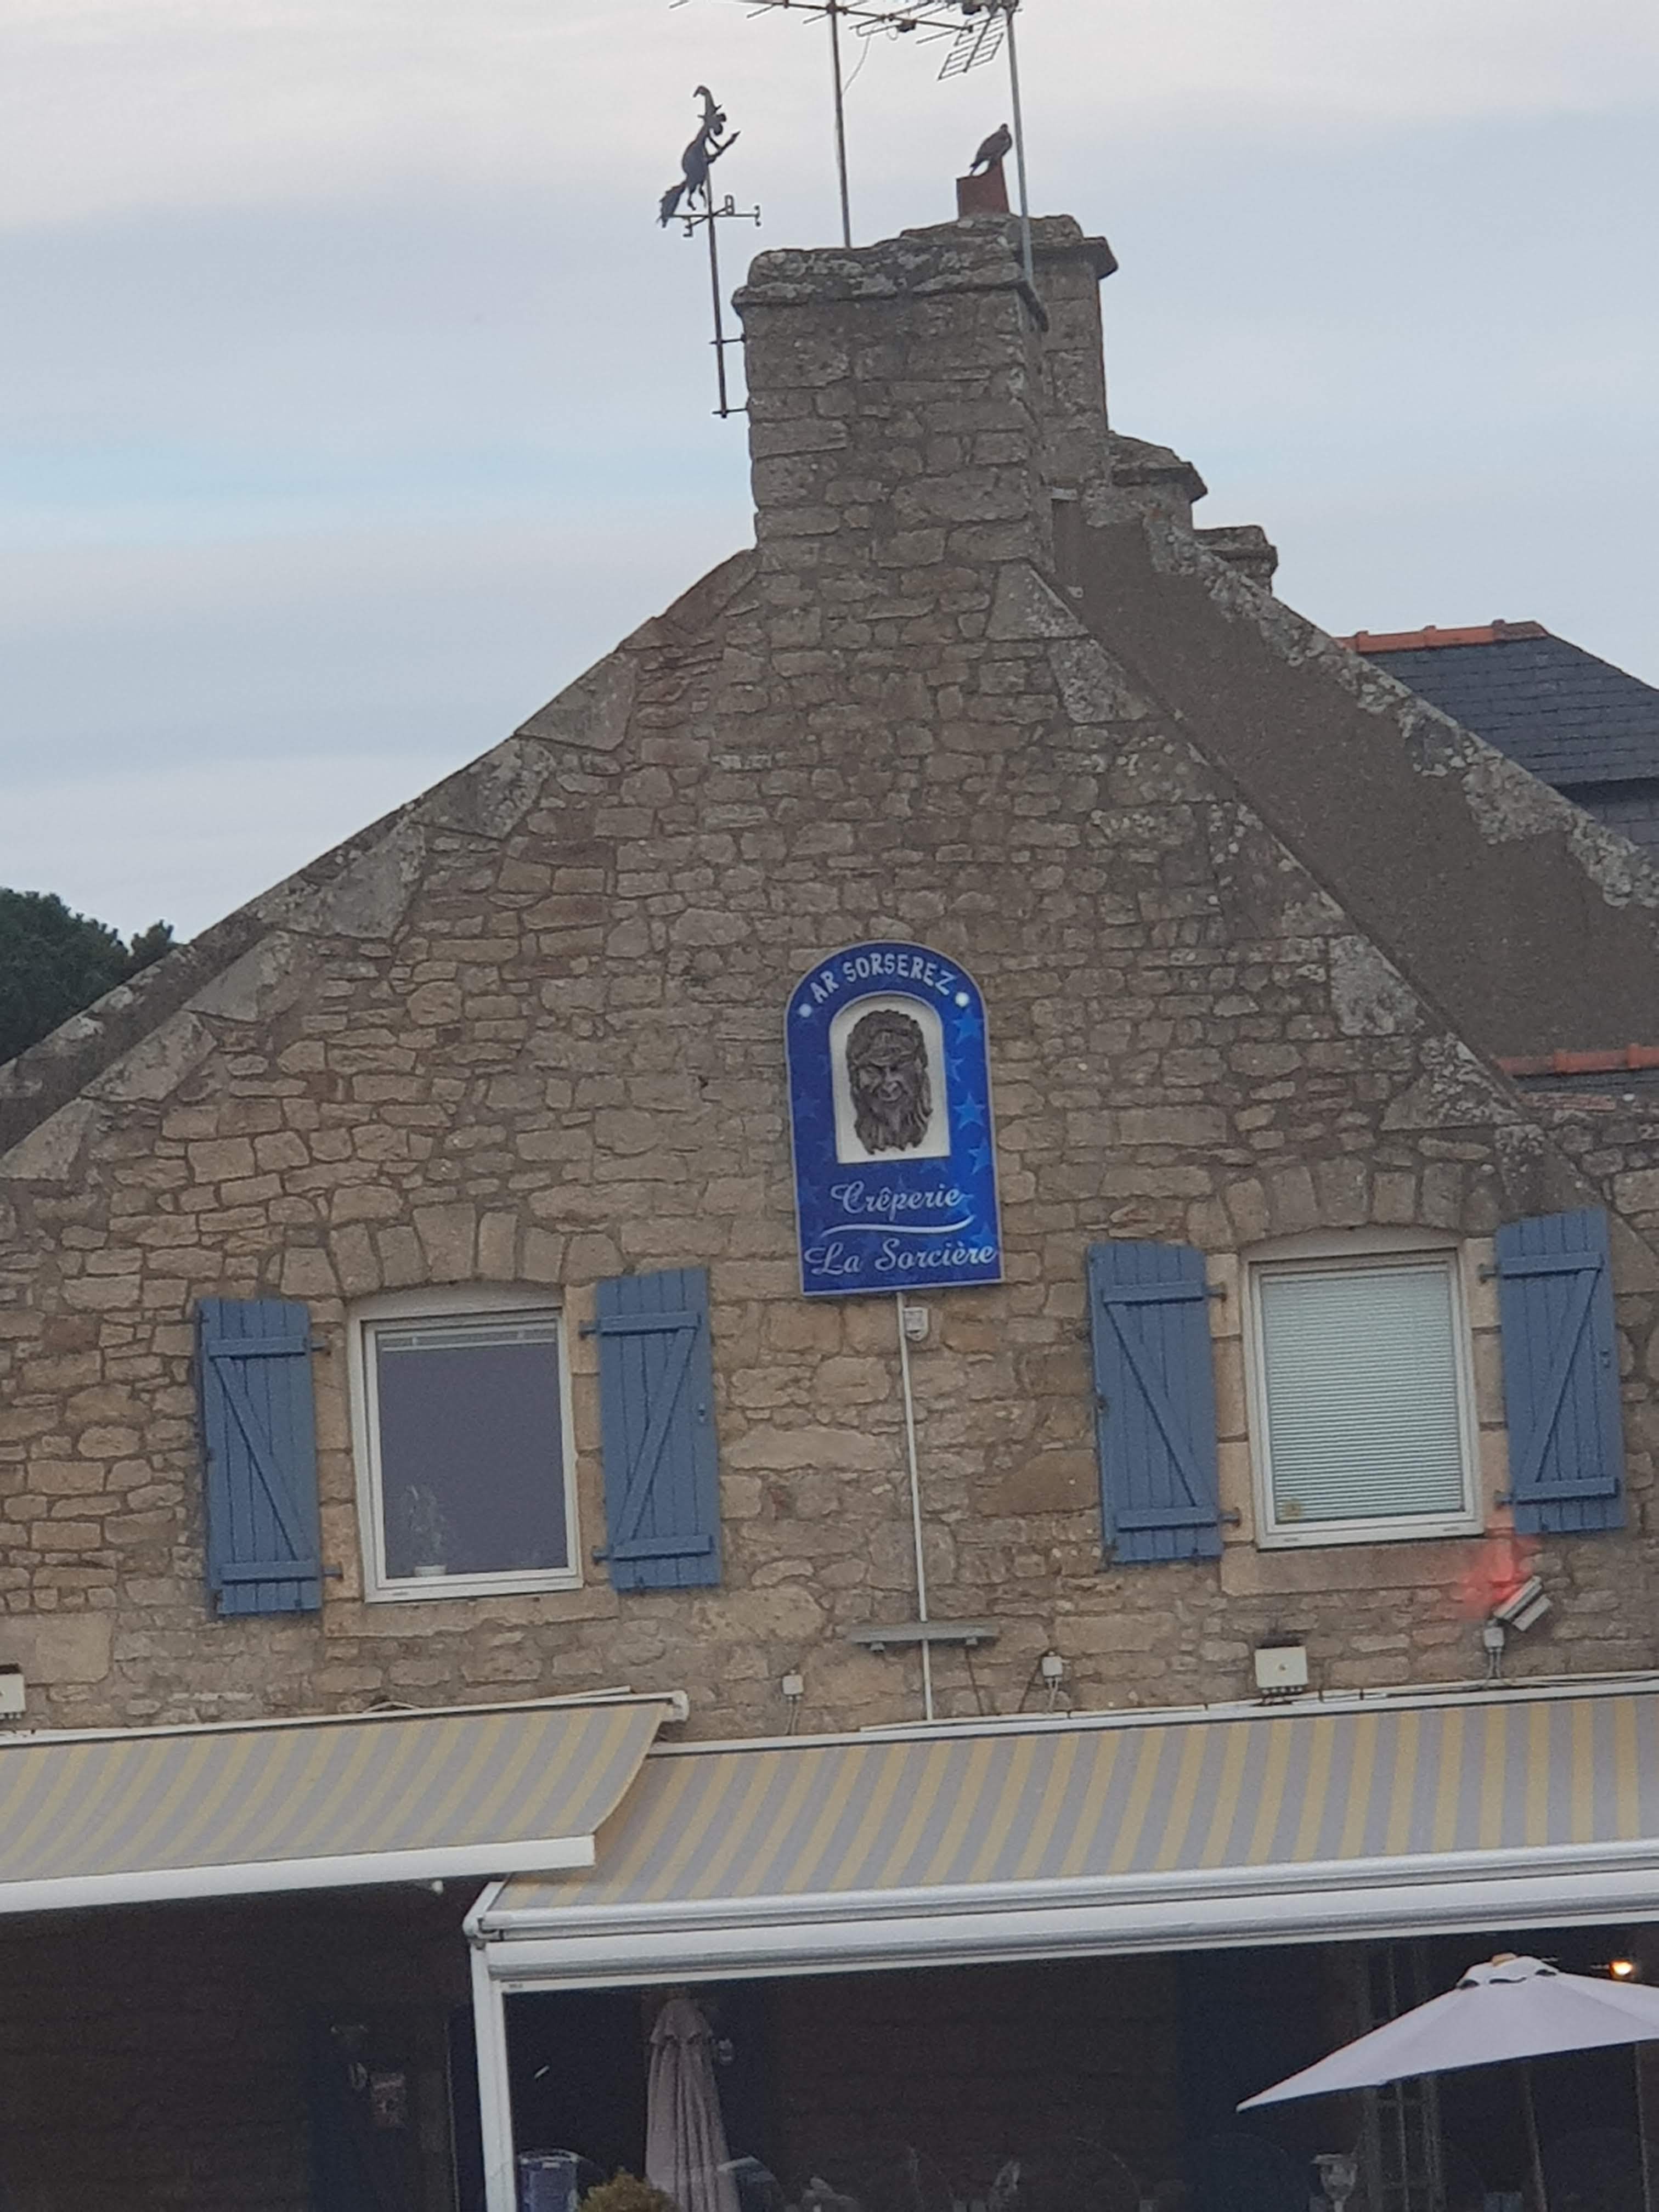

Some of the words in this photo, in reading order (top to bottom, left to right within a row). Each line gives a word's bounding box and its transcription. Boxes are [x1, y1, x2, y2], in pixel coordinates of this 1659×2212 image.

[810, 970, 839, 1003] AR
[843, 953, 955, 995] SORSEREZ
[831, 1180, 967, 1221] Crêperie
[804, 1242, 861, 1275] La
[874, 1238, 997, 1272] Sorcière
